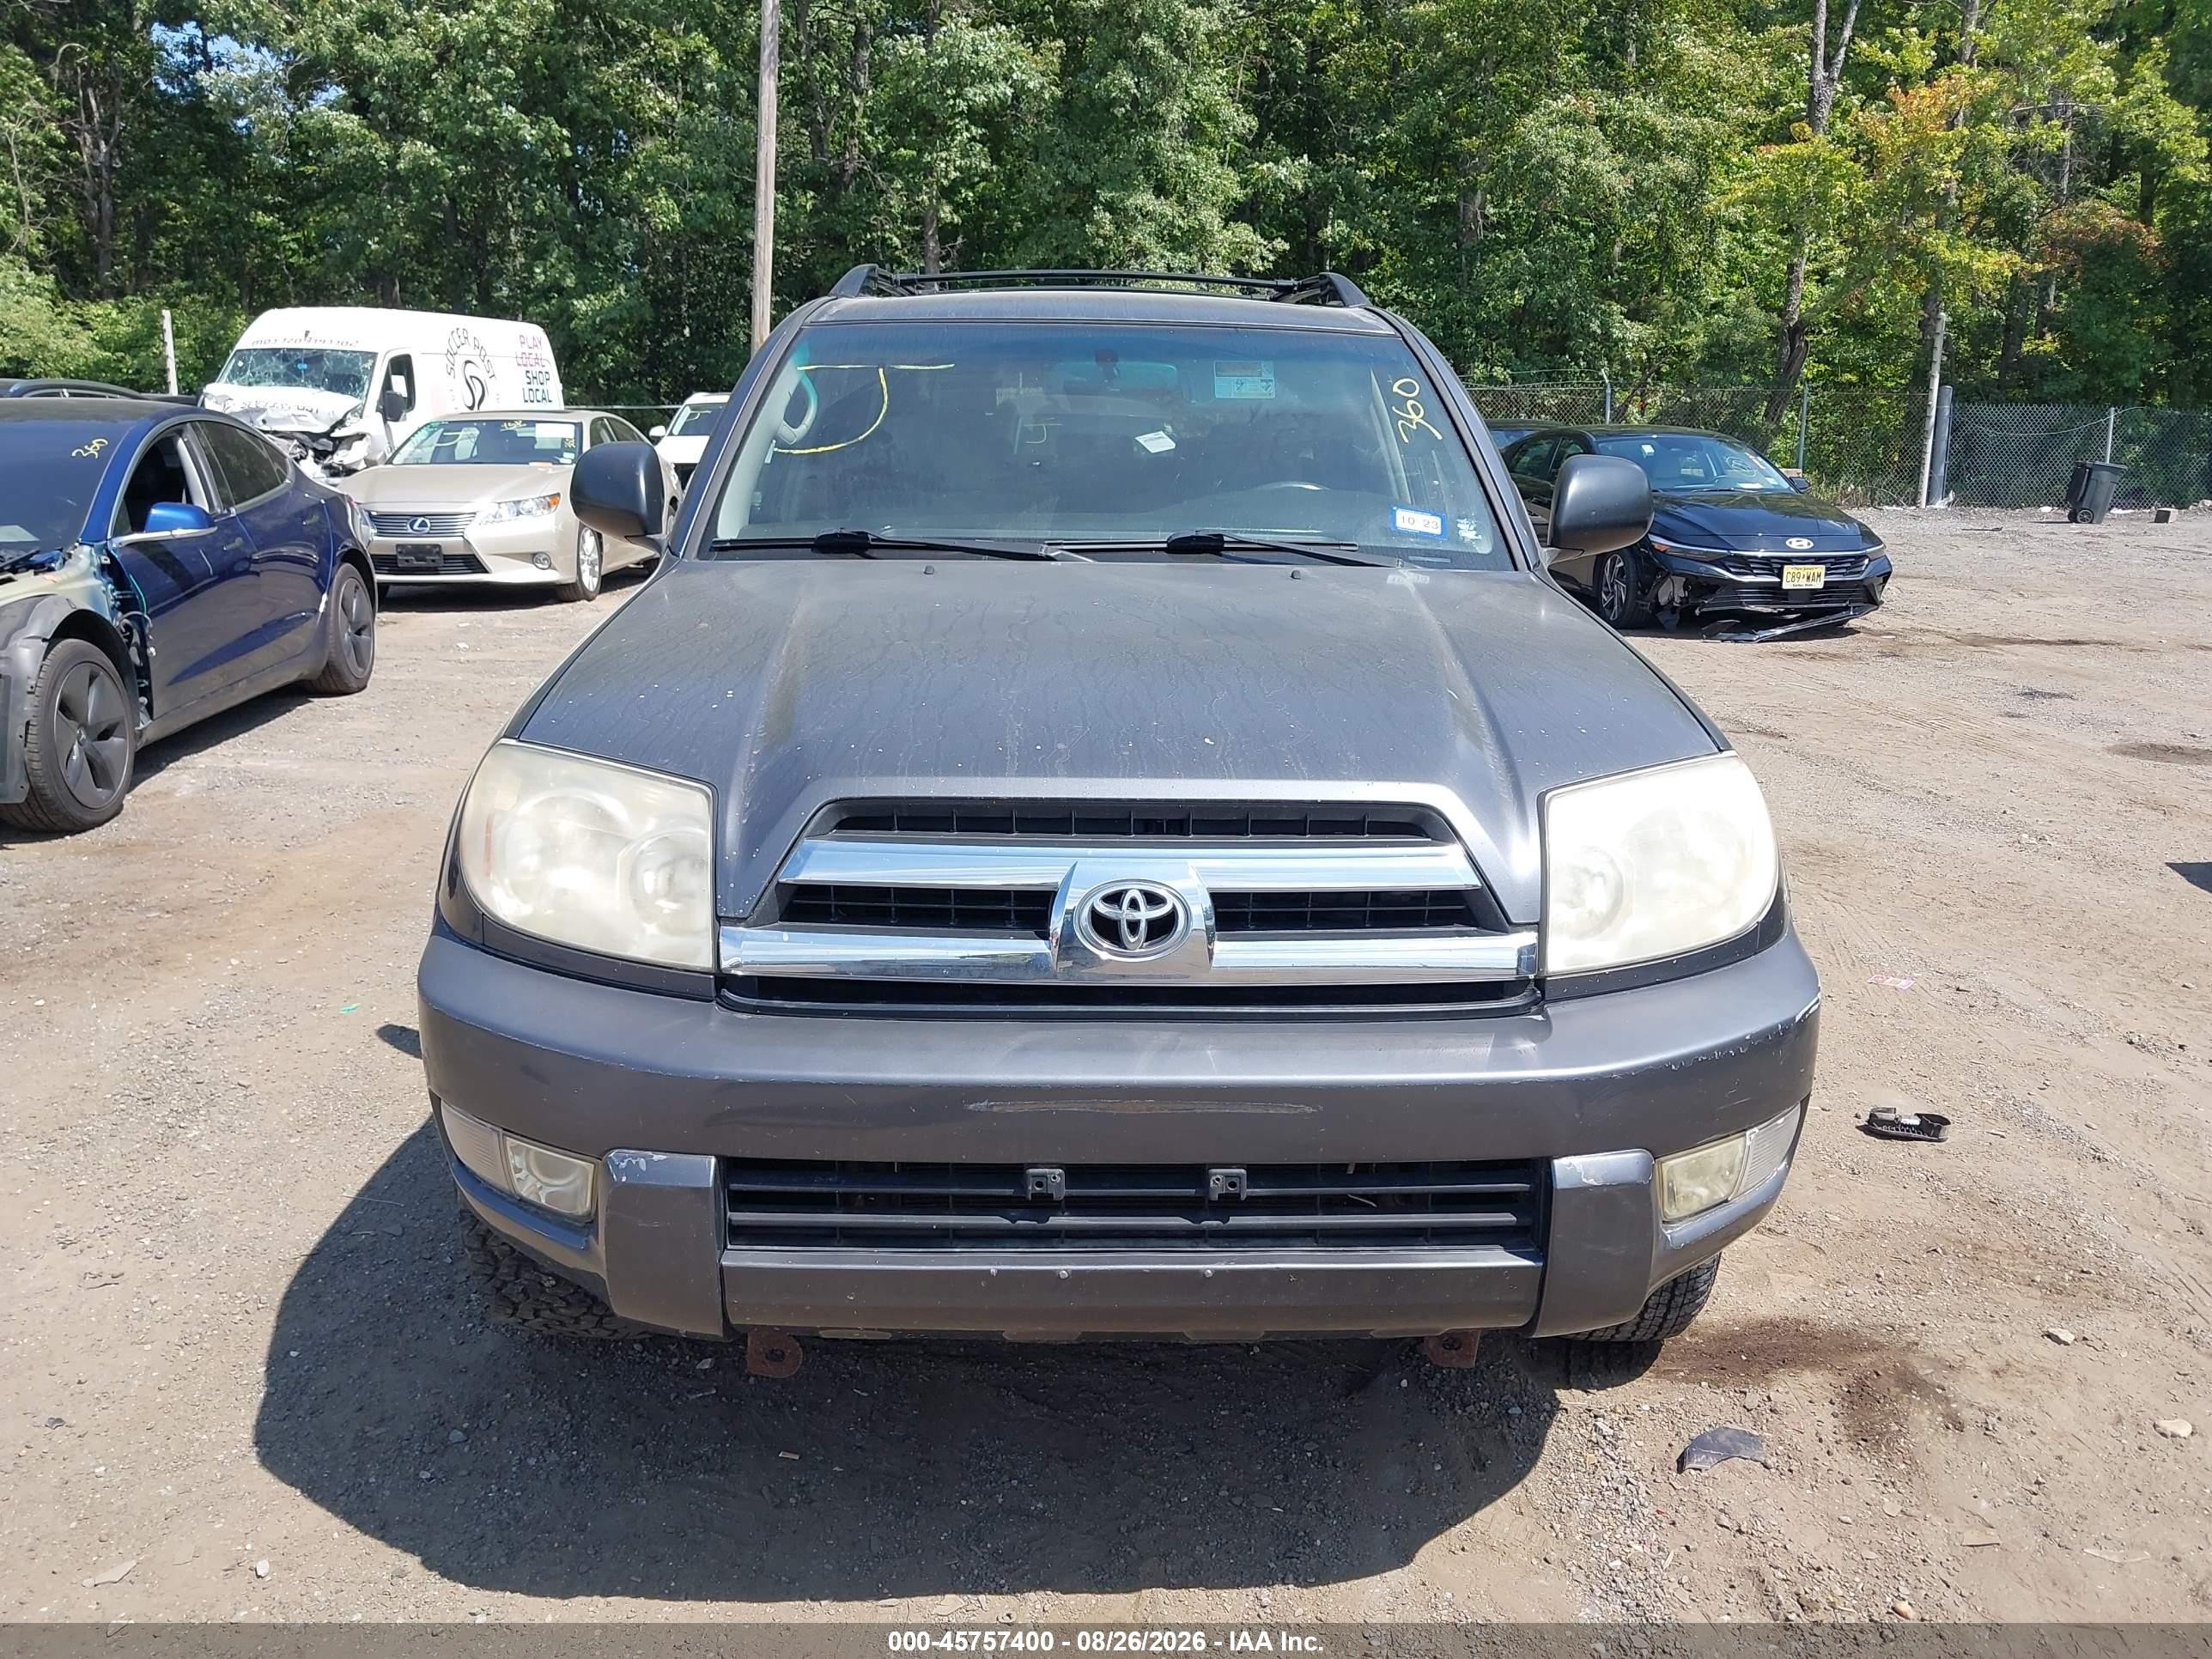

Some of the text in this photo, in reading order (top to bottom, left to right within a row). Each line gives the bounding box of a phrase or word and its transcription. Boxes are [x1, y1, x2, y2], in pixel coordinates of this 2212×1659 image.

[519, 334, 542, 350] PLAY
[473, 336, 496, 380] POST
[515, 351, 545, 368] LOCAL
[525, 370, 550, 386] SHOP
[522, 388, 553, 404] LOCAL
[1392, 378, 1443, 443] 360
